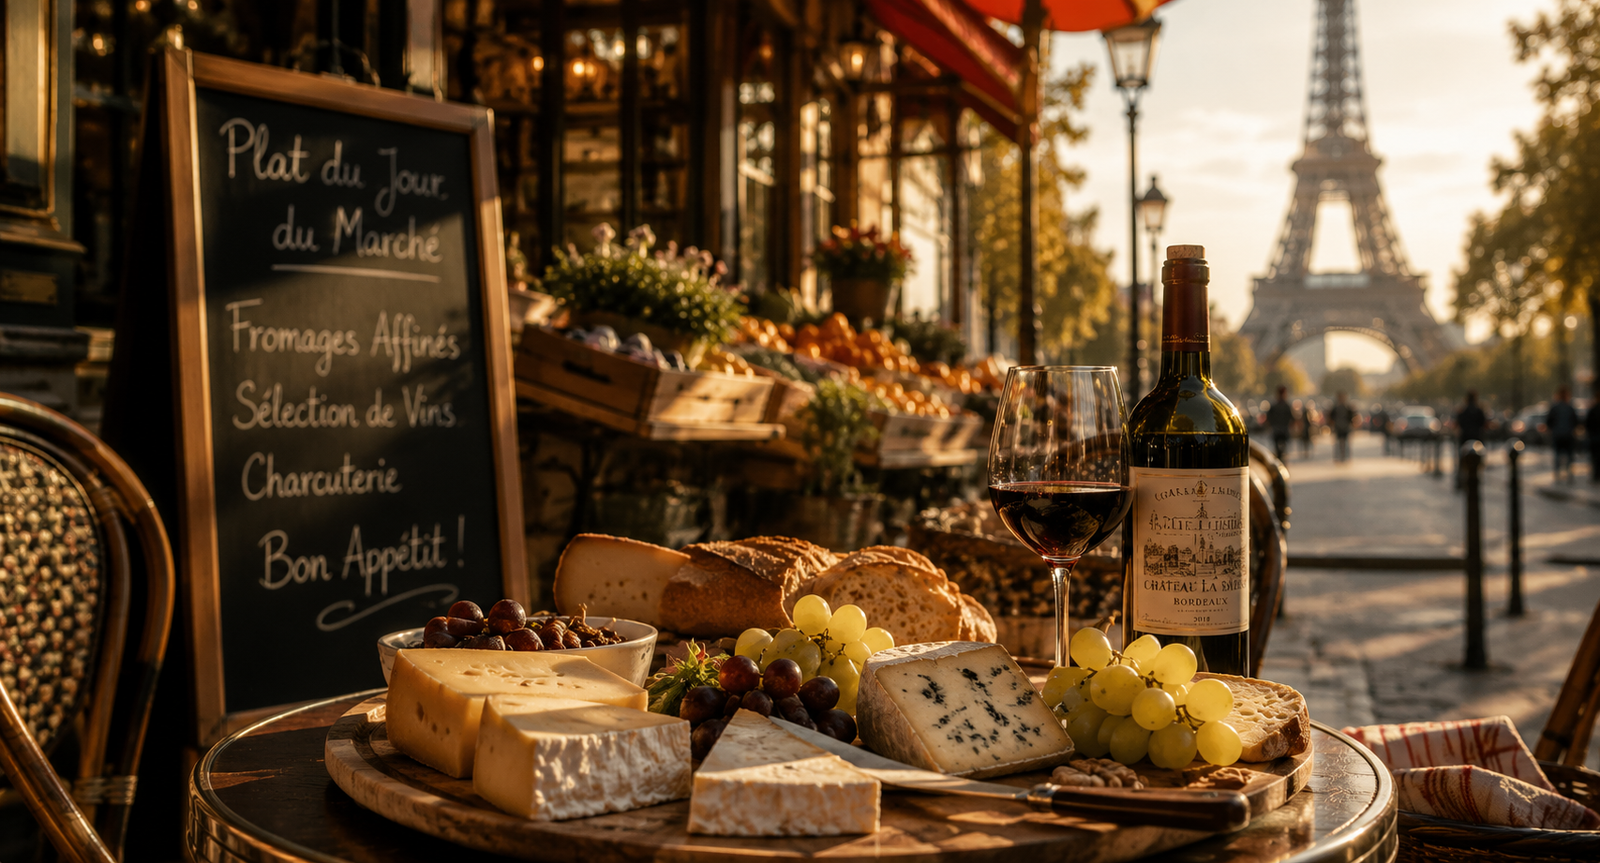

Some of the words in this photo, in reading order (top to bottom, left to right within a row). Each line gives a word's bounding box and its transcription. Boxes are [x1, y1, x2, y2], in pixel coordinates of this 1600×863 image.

[219, 117, 310, 184] Plat
[320, 139, 365, 189] du
[272, 204, 320, 252] du
[332, 206, 444, 263] Marché
[225, 298, 361, 377] Fromages
[369, 310, 461, 373] Affinés
[232, 379, 361, 430] Sélection
[365, 387, 398, 428] de
[402, 383, 457, 428] Vins
[241, 452, 403, 501] Charcuterie
[258, 529, 333, 590] Bon
[341, 524, 447, 596] Appétit
[457, 514, 465, 568] !
[1173, 597, 1229, 607] BORDEAUX
